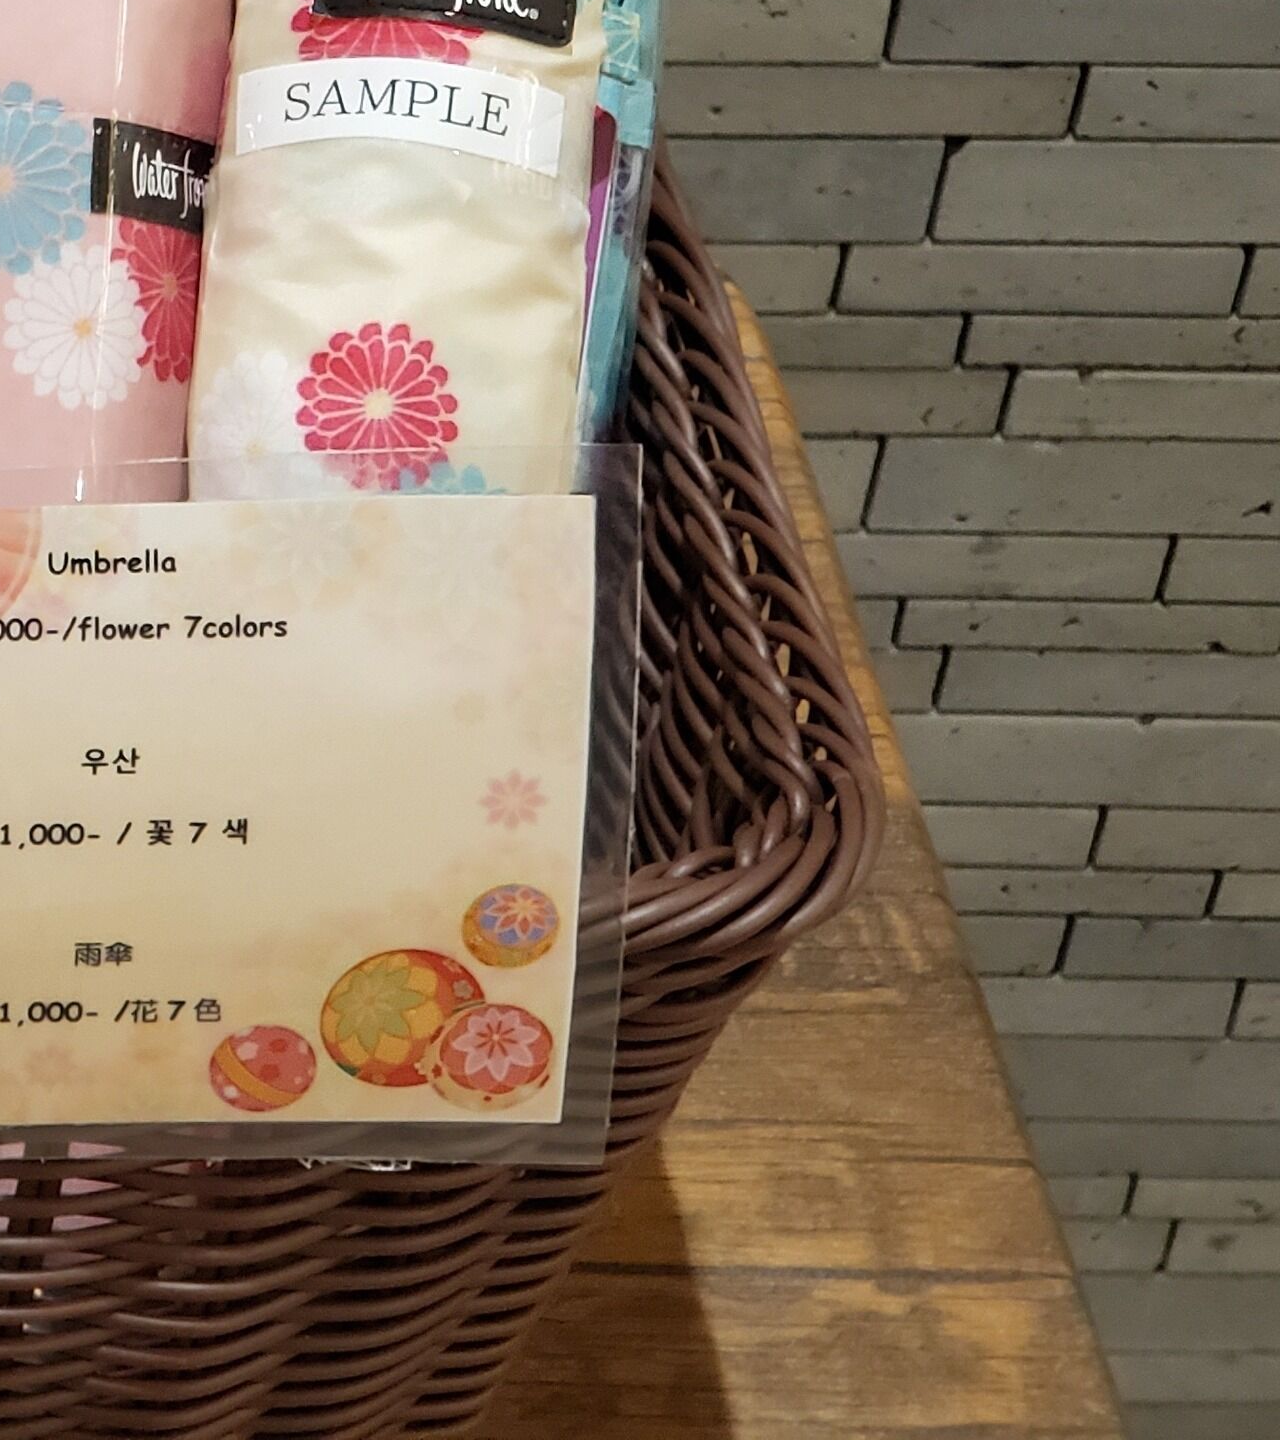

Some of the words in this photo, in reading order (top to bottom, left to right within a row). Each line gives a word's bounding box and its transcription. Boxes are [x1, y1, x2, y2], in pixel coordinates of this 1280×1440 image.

[283, 77, 512, 137] SAMPLE
[131, 141, 180, 201] Water
[180, 148, 206, 220] fro
[47, 548, 177, 576] Umbrella
[183, 613, 288, 639] 7colors
[80, 747, 141, 776] 우산
[146, 819, 175, 846] 꽃
[188, 821, 208, 844] 7
[221, 818, 249, 845] 색
[73, 941, 134, 967] 雨傘
